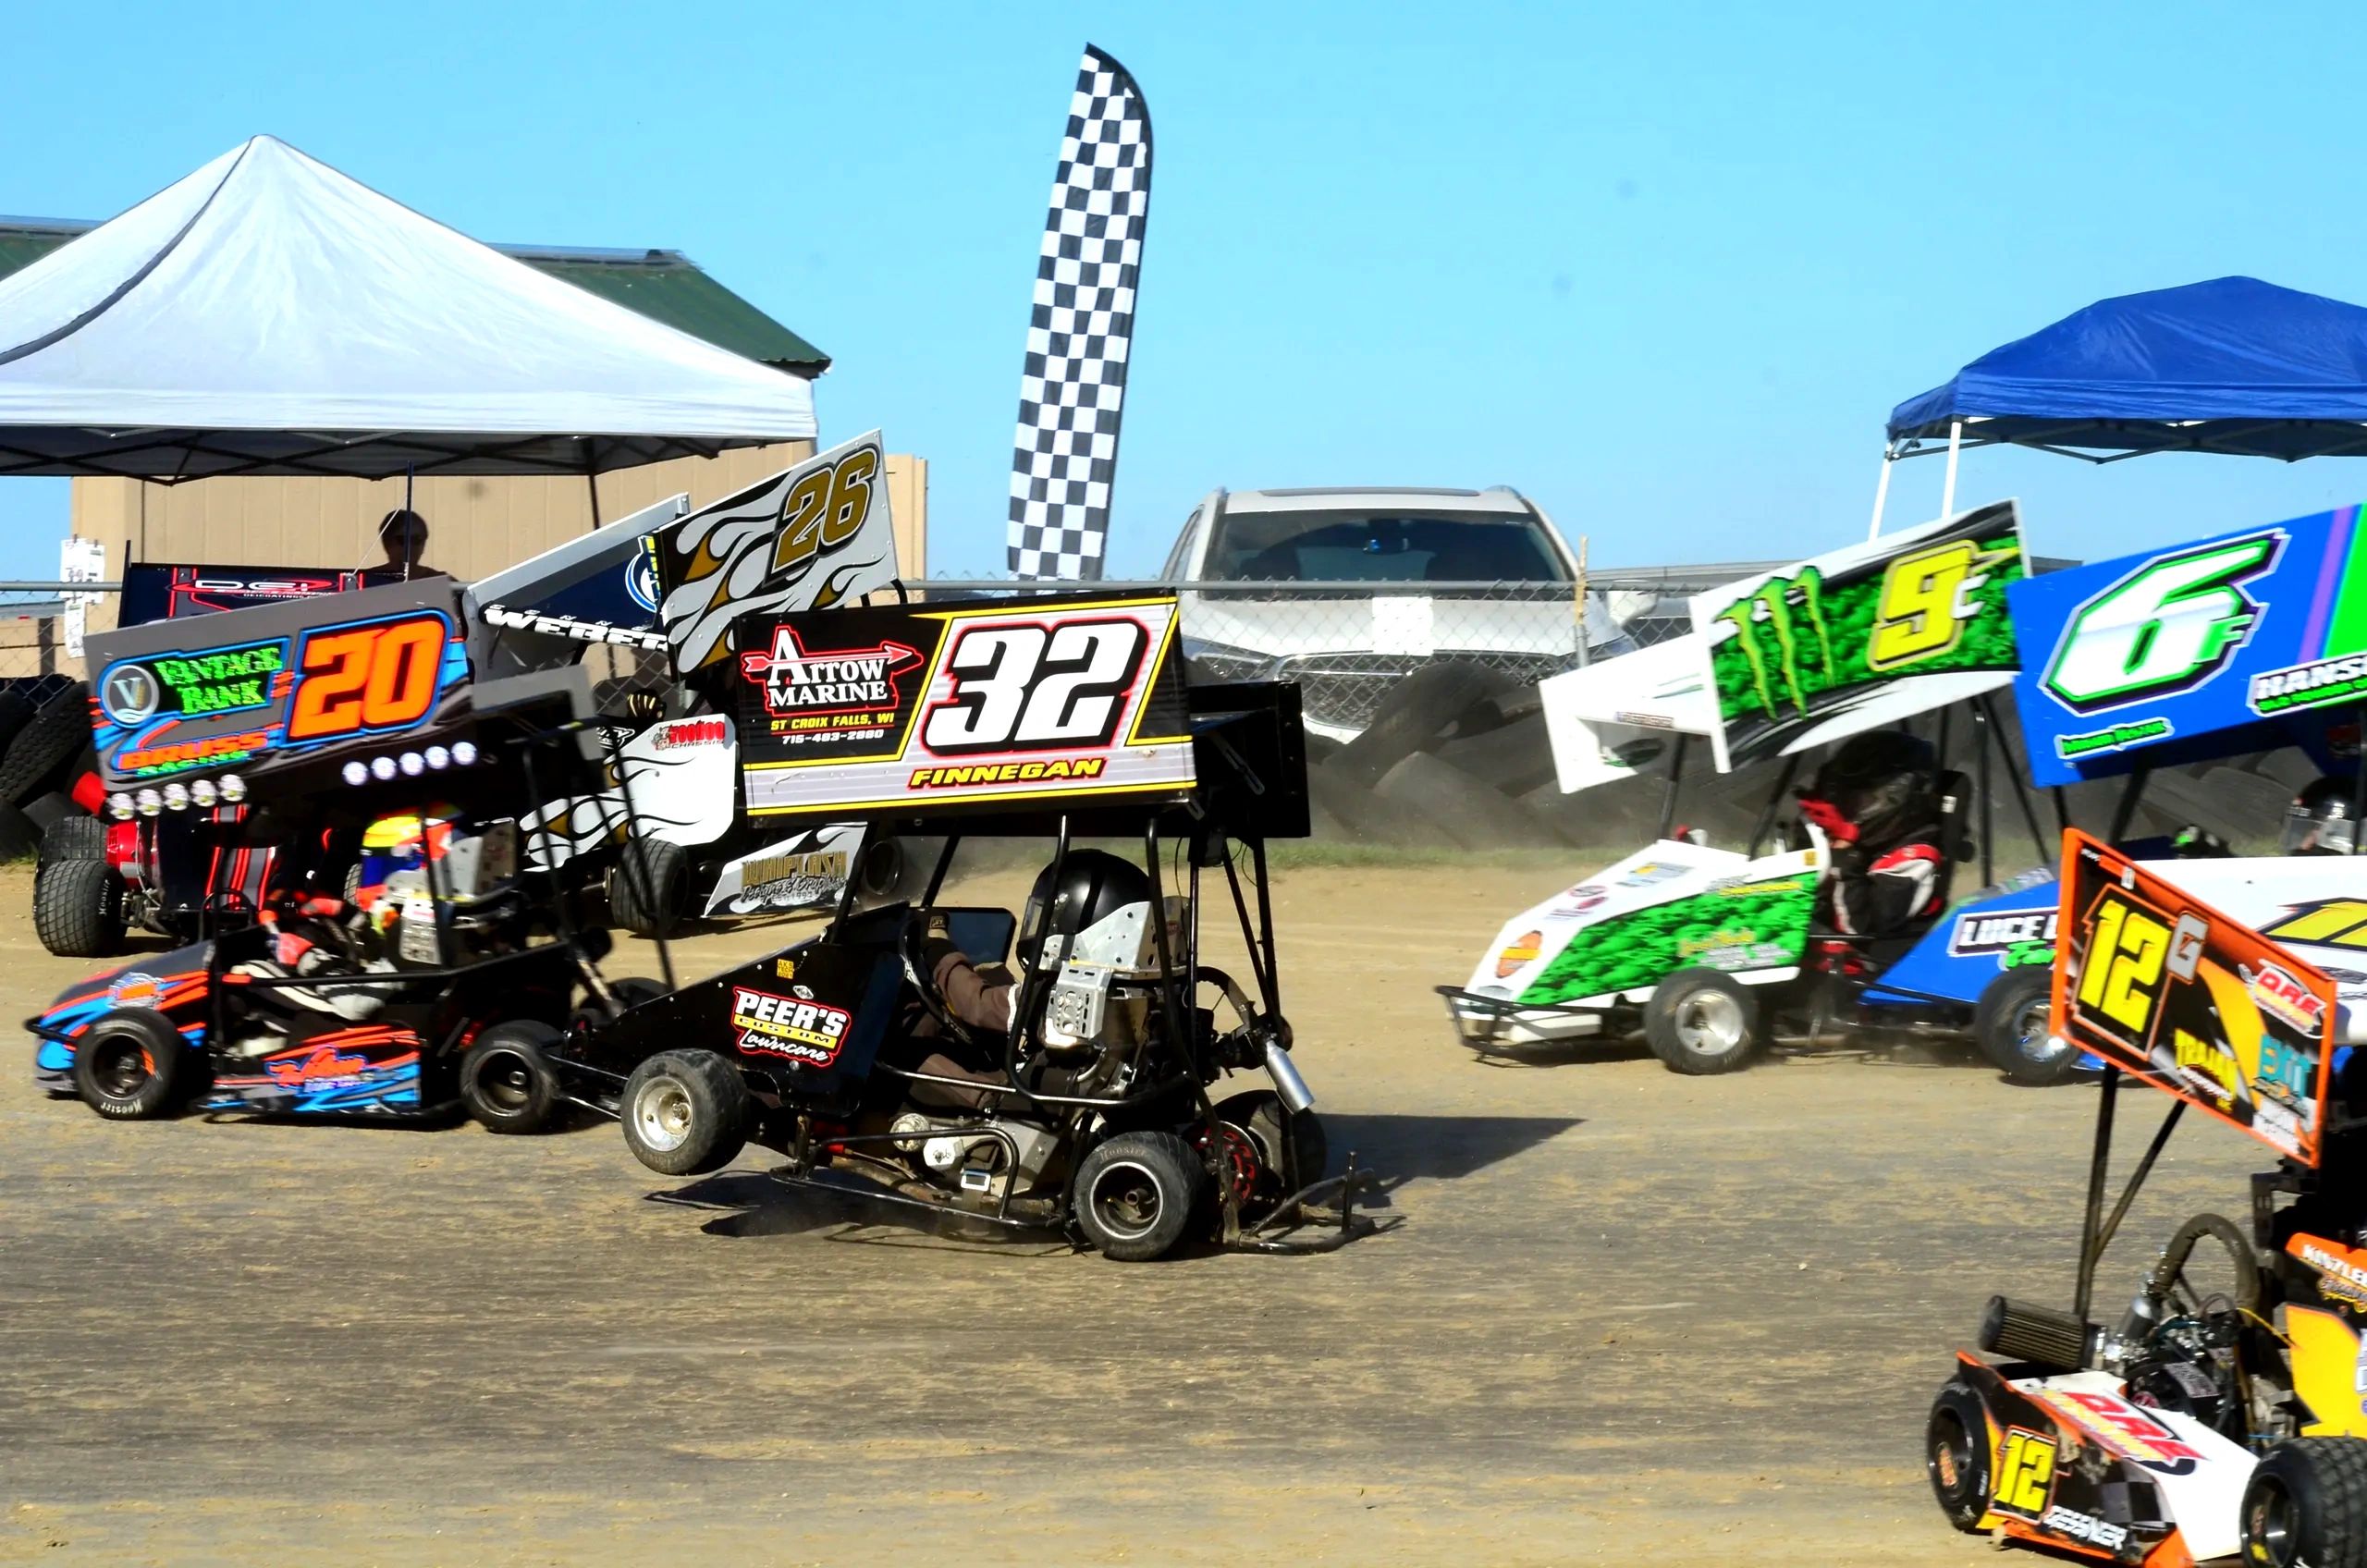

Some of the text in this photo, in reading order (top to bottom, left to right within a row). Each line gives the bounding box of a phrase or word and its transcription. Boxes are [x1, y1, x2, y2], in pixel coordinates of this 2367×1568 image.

[771, 444, 881, 577] 26
[177, 680, 265, 714] BANK
[289, 620, 445, 738] 20
[767, 681, 889, 707] MARINE
[925, 620, 1139, 749] 32
[770, 713, 895, 730] ST CROIX FALLS, WI
[117, 730, 268, 770] BRUSS
[671, 740, 724, 750] CHASSIS
[909, 757, 1105, 788] FINNEGAN
[742, 851, 848, 888] WHIPLASH
[735, 990, 847, 1036] PEER'S
[739, 1017, 830, 1044] CUSTOM
[739, 1028, 828, 1060] Lawncare
[2302, 1243, 2367, 1289] KINZLE
[1993, 1435, 2056, 1513] 12
